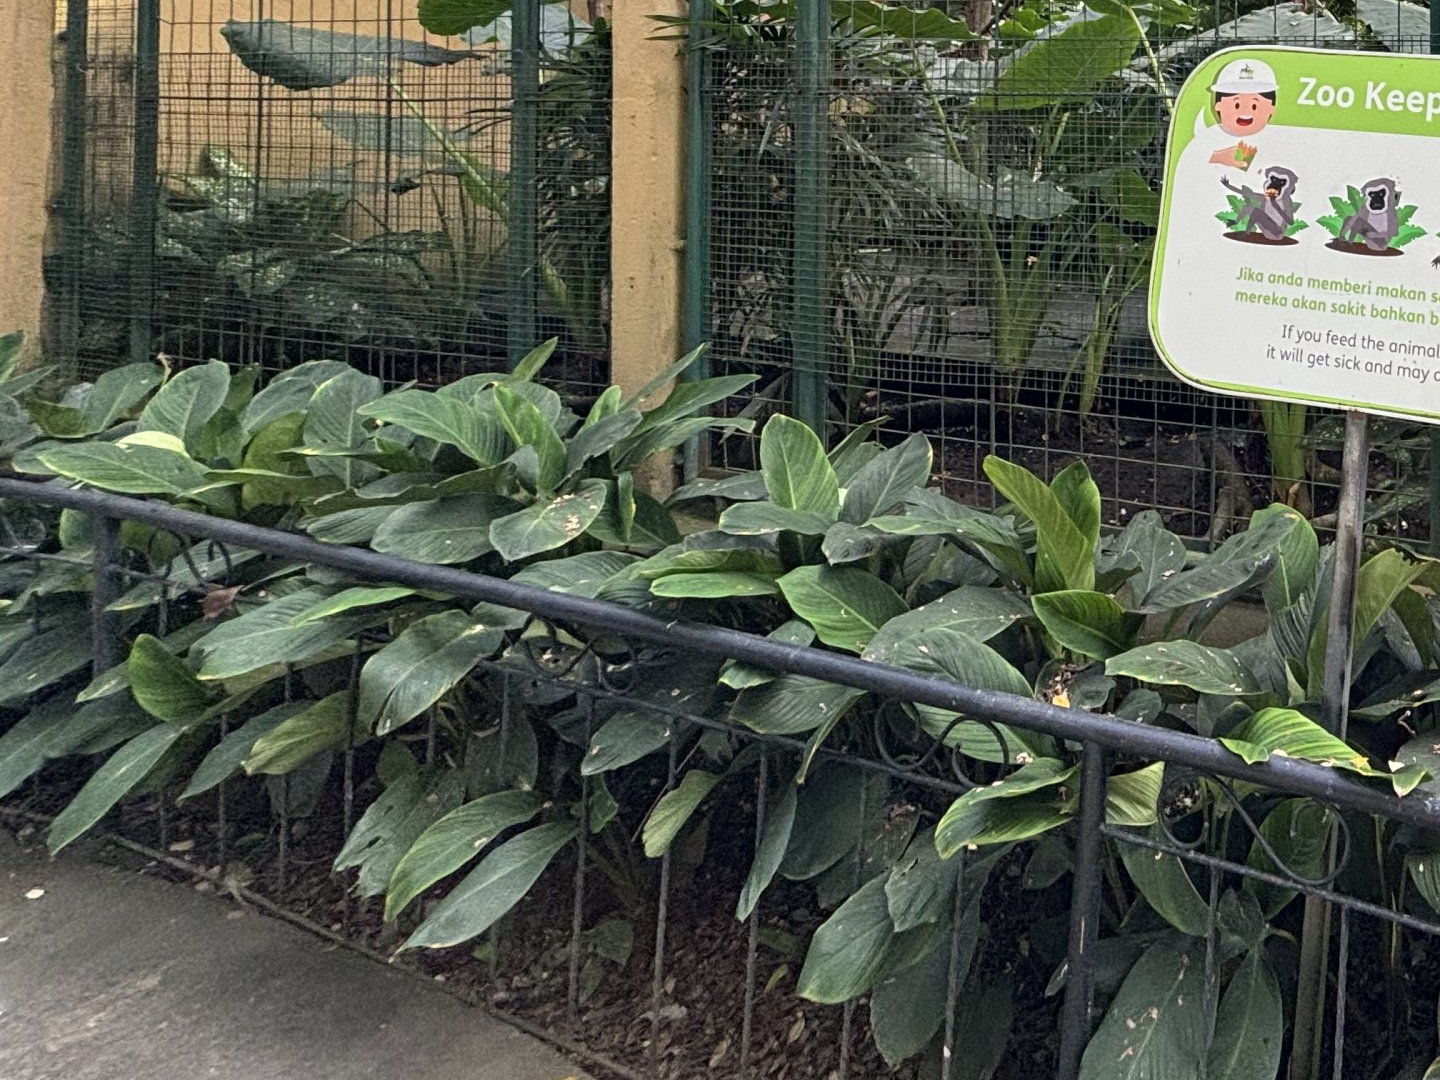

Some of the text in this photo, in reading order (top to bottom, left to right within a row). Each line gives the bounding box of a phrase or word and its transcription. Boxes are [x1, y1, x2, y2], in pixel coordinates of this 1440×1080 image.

[1297, 77, 1355, 108] Zoo
[1235, 267, 1264, 283] Jika
[1268, 272, 1303, 287] anda
[1307, 278, 1372, 295] memberi
[1376, 284, 1427, 302] makan
[1235, 290, 1288, 308] mereka
[1292, 295, 1327, 313] akan
[1331, 300, 1367, 317] sakit
[1371, 304, 1426, 324] bahkan
[1282, 324, 1295, 339] If
[1296, 330, 1321, 344] you
[1326, 329, 1357, 347] feed
[1361, 335, 1385, 351] the
[1266, 344, 1276, 359] it
[1280, 348, 1304, 363] will
[1307, 352, 1330, 368] get
[1334, 355, 1361, 371] sick
[1365, 360, 1393, 376] and
[1398, 365, 1430, 384] may
